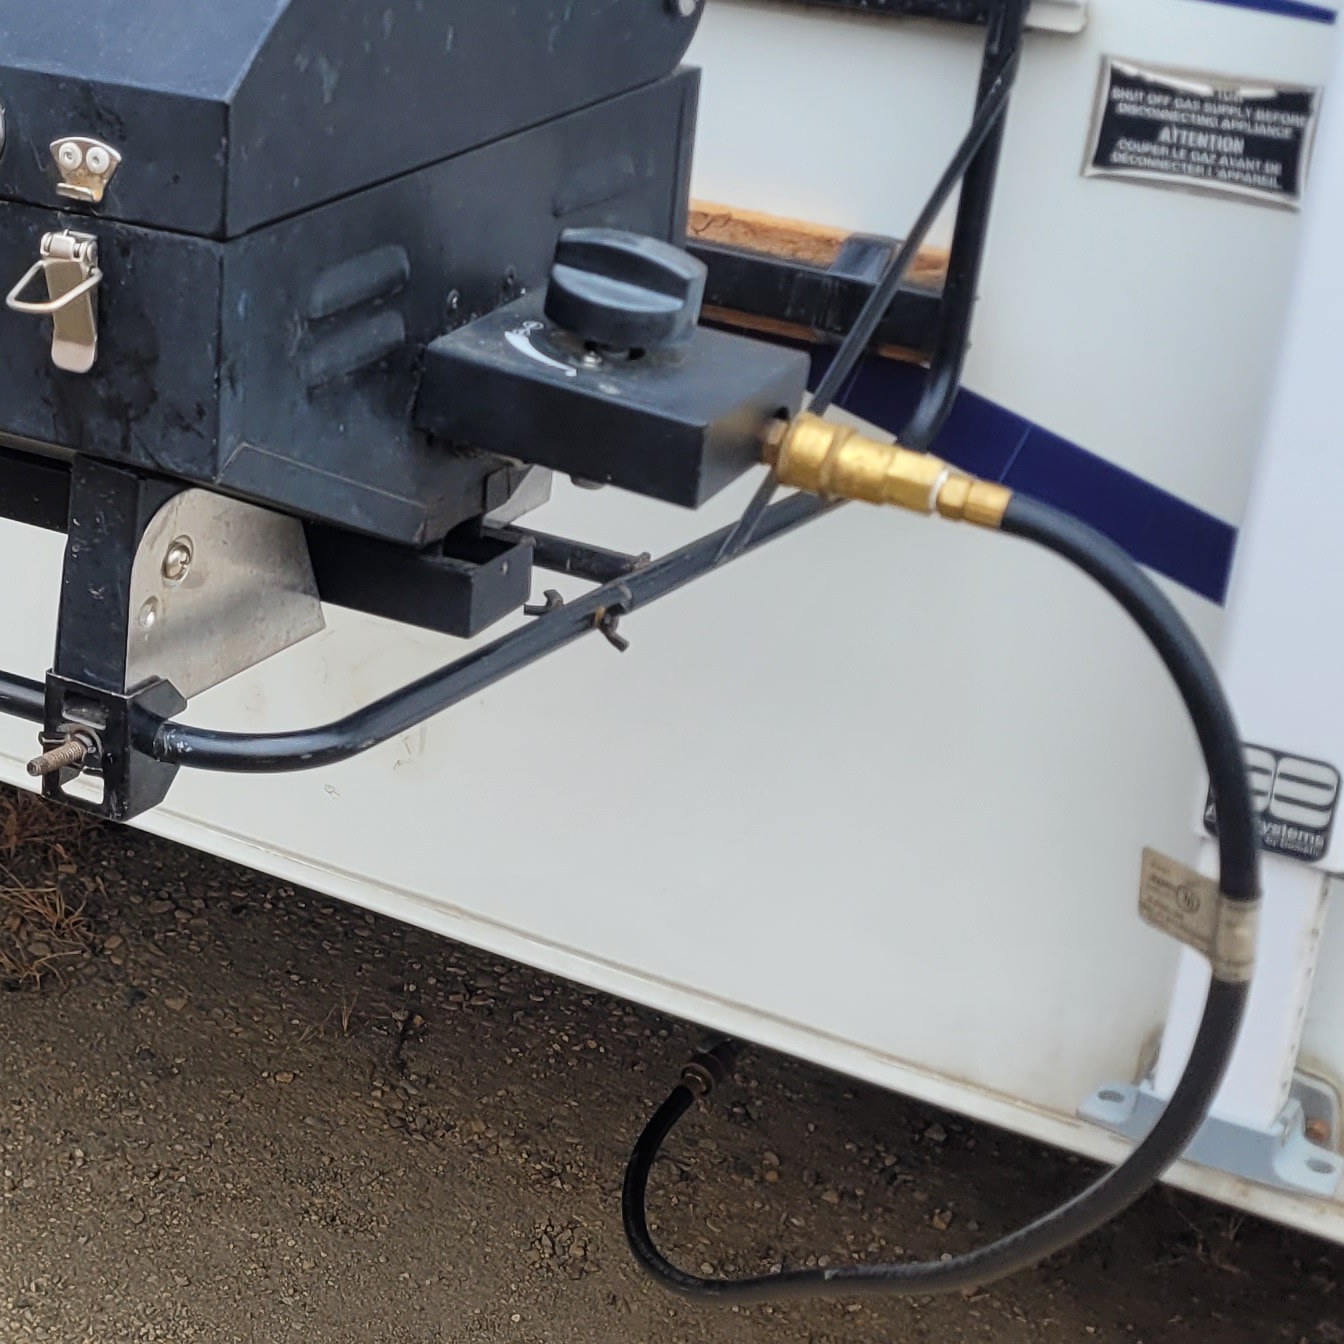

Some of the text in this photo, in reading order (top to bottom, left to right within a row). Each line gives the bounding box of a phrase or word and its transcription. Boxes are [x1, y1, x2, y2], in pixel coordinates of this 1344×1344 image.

[1112, 87, 1144, 103] SHUT
[1158, 125, 1244, 153] ATTENTION
[1260, 822, 1324, 846] ystems
